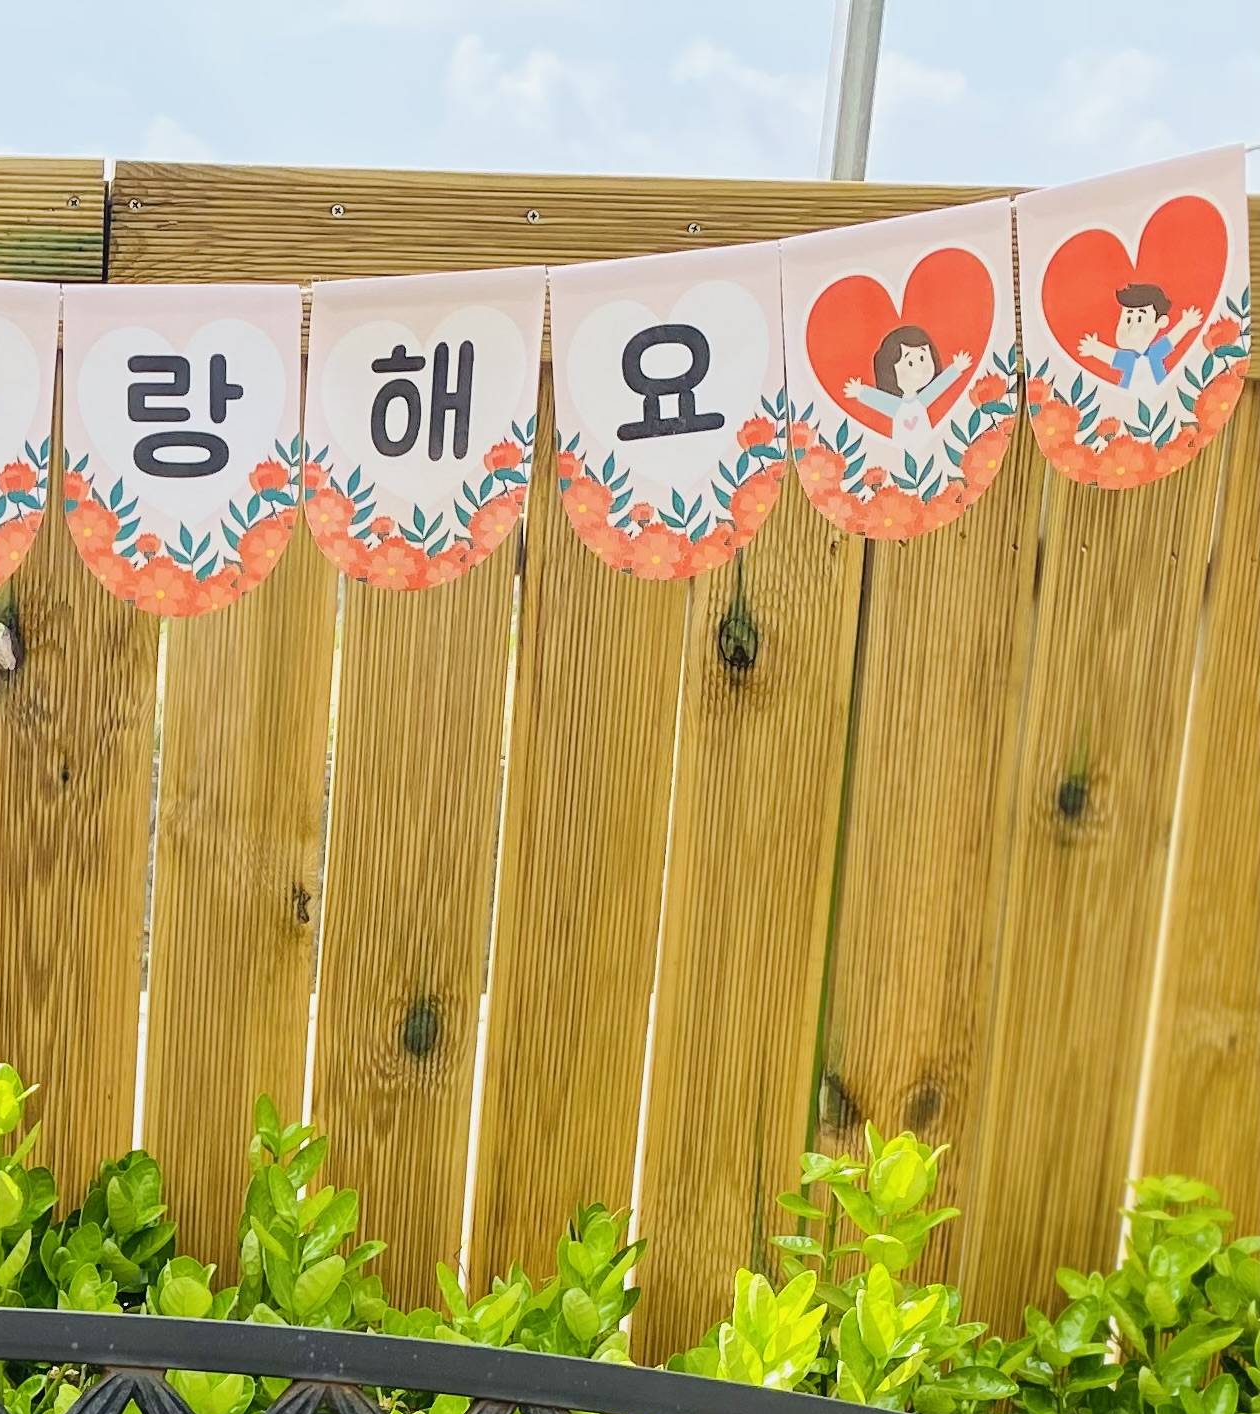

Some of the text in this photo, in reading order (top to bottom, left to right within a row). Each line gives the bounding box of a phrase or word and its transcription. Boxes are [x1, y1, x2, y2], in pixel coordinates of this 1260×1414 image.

[126, 352, 245, 480] 랑
[369, 339, 476, 463] 해
[615, 322, 726, 443] 요
